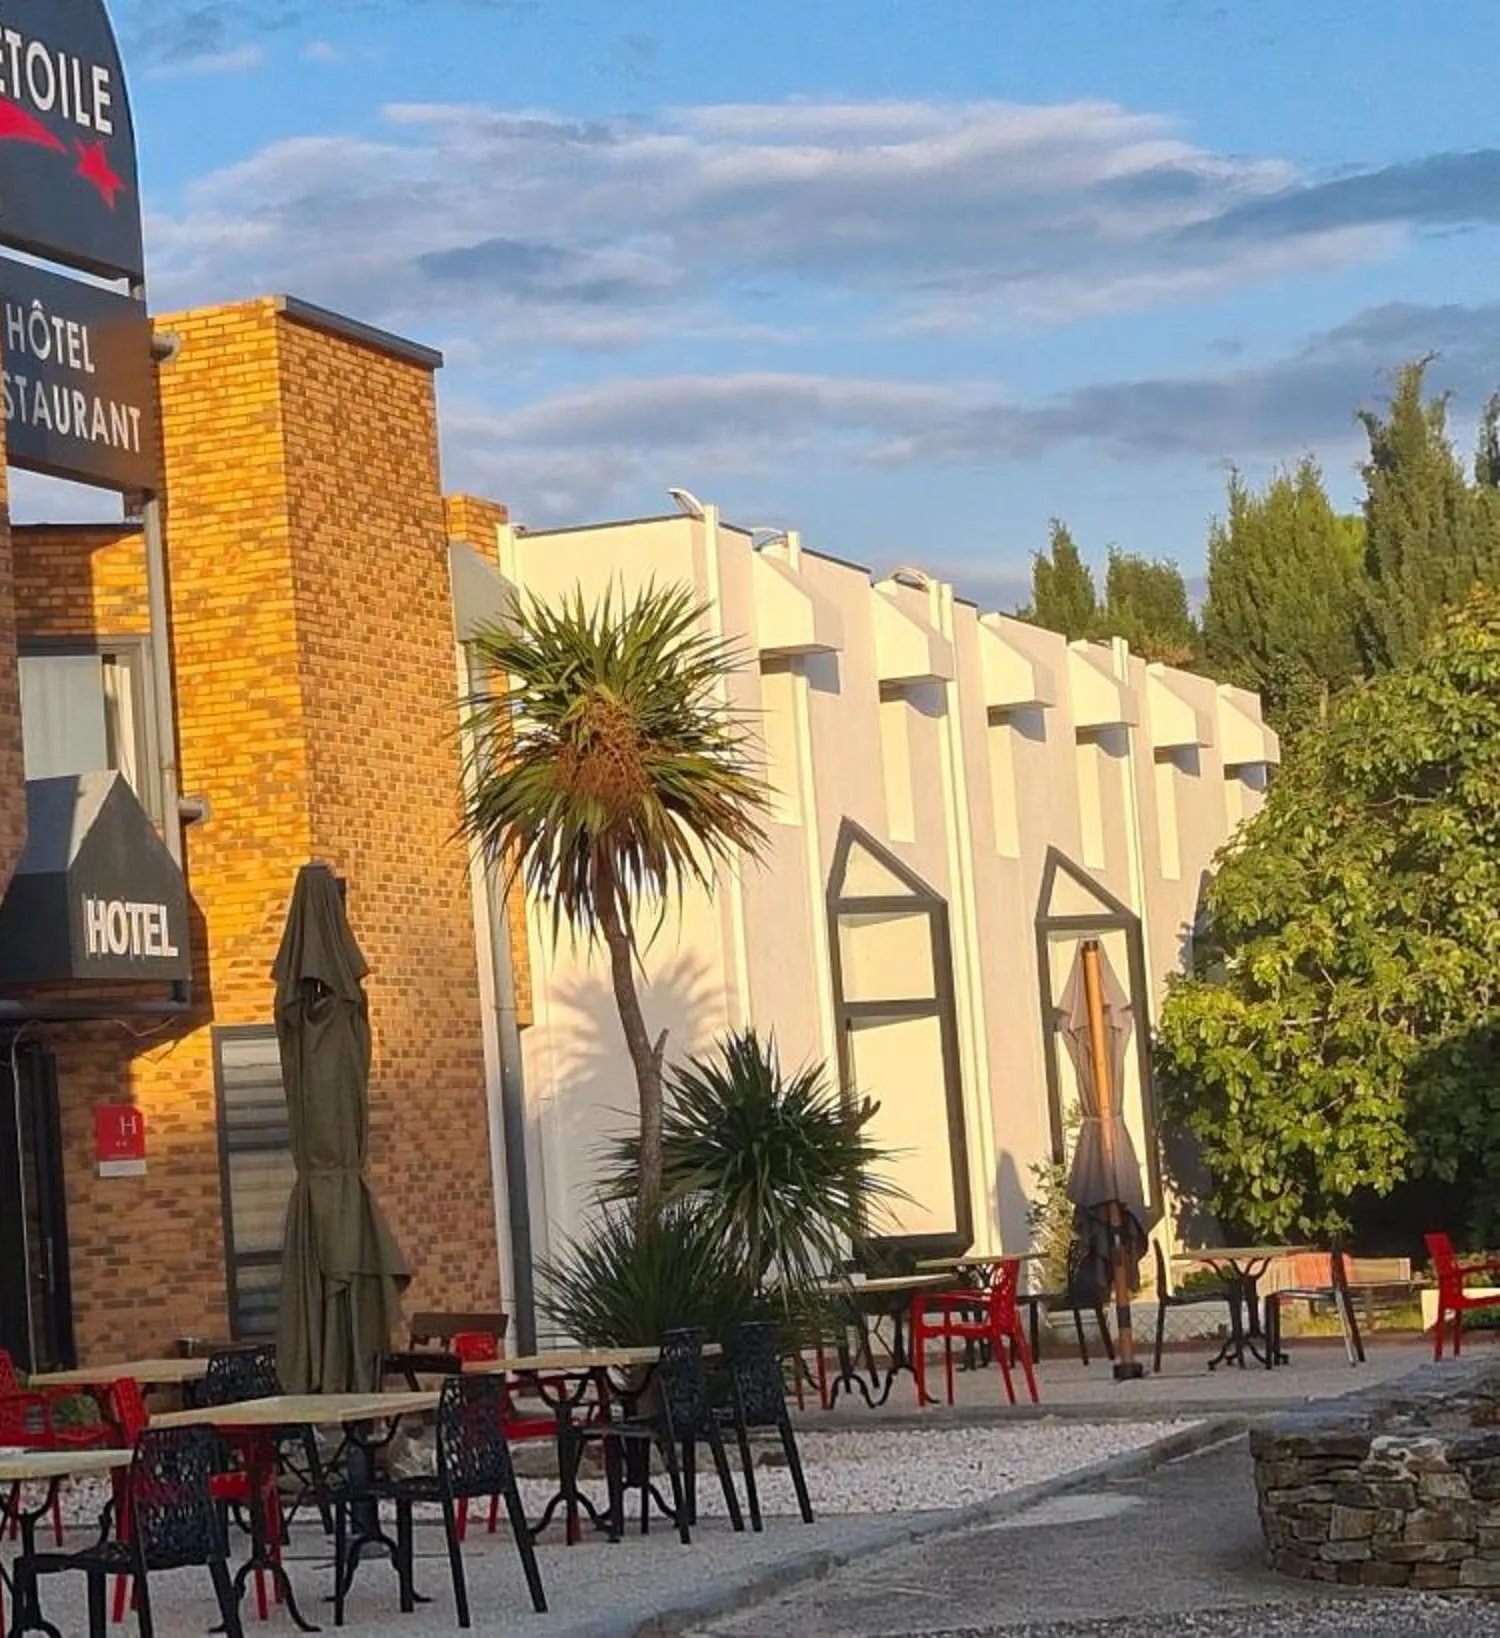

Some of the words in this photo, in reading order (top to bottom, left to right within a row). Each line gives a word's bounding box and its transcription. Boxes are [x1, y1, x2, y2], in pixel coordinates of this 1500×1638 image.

[6, 300, 95, 373] HÔTEL
[86, 899, 179, 957] HOTEL
[120, 1115, 137, 1136] H
